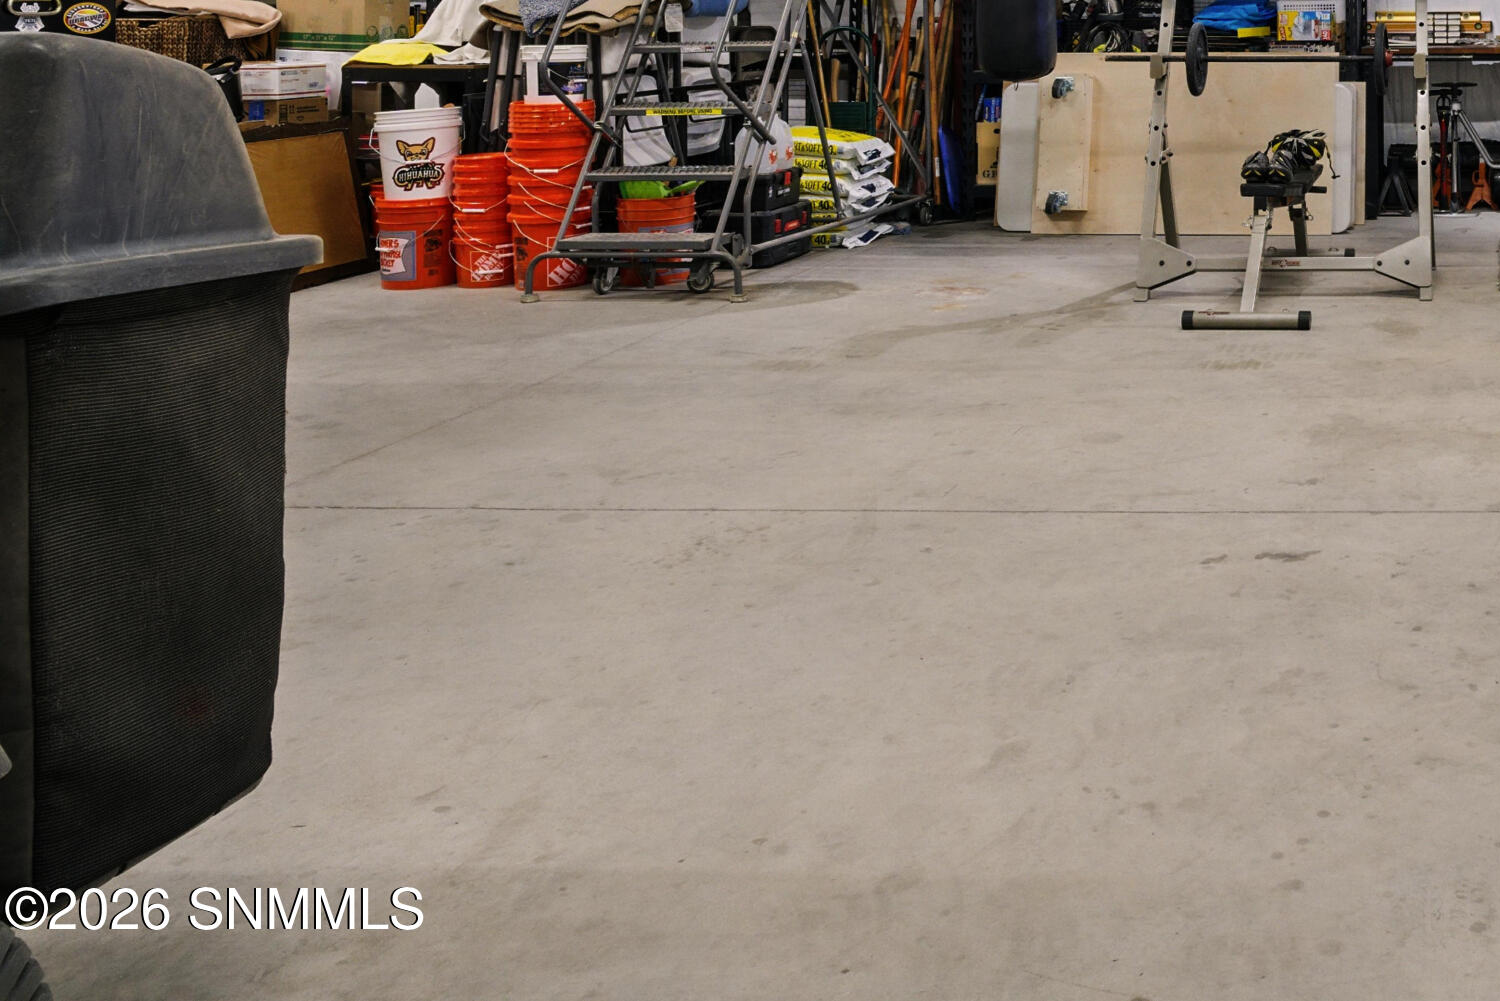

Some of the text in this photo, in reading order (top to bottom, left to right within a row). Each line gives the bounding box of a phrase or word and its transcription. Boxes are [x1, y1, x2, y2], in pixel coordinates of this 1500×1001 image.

[801, 159, 817, 169] SOFT
[394, 163, 444, 188] CHIHUAHUAS
[804, 181, 820, 191] SOFT
[818, 200, 829, 210] 40
[814, 234, 826, 244] 40
